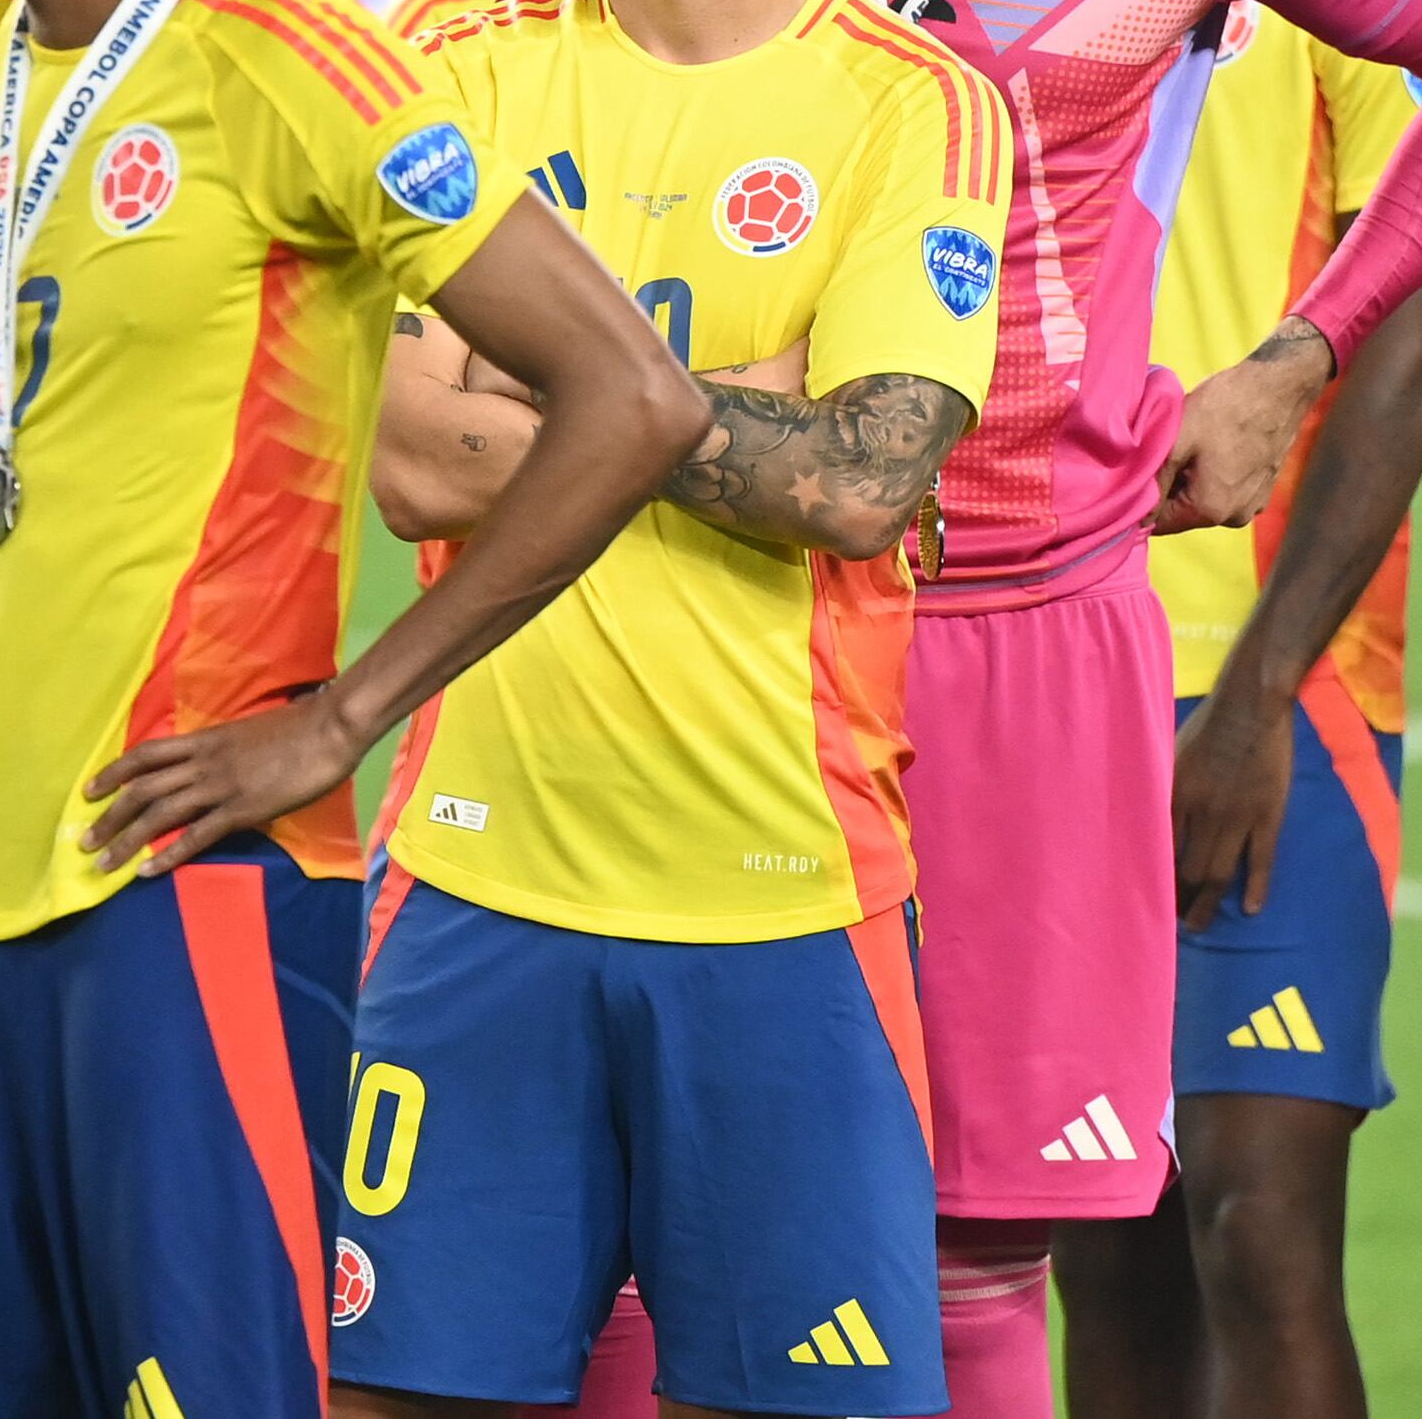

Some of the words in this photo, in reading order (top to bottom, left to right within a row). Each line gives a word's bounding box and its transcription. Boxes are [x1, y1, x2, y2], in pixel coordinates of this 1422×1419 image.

[51, 86, 95, 146] COPA
[395, 142, 459, 193] VIBRA
[933, 247, 988, 279] VIBRA
[743, 852, 819, 873] HEAT.RDY
[342, 1051, 426, 1217] 0
